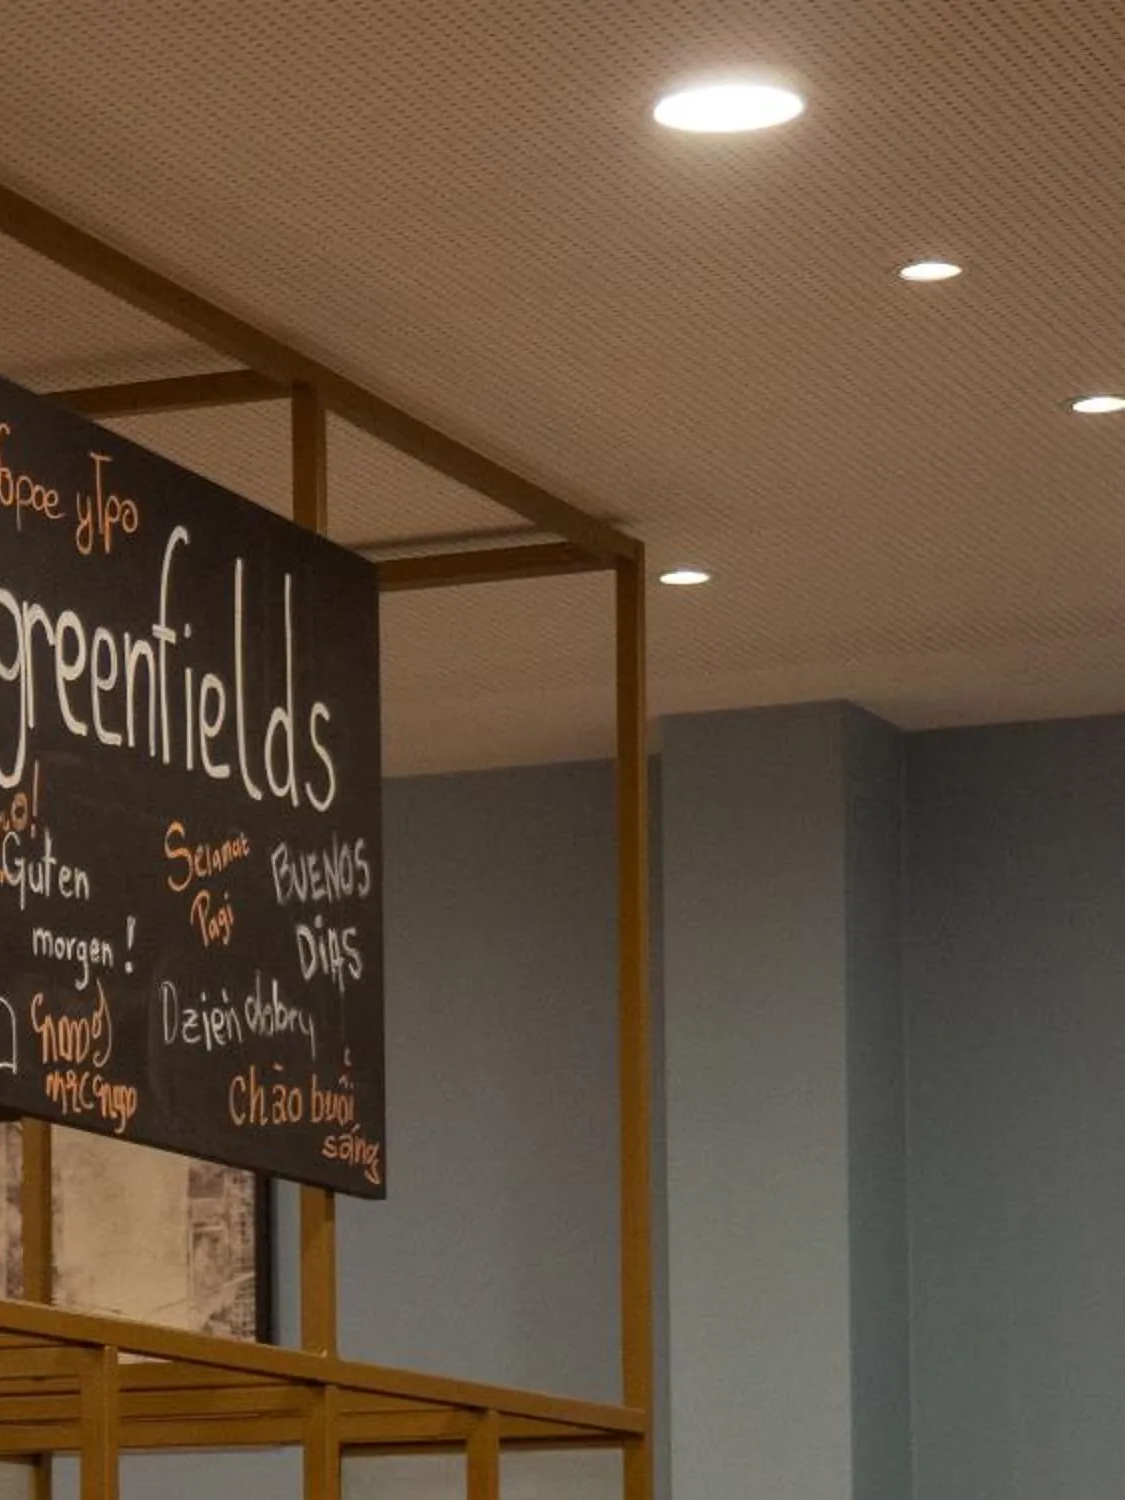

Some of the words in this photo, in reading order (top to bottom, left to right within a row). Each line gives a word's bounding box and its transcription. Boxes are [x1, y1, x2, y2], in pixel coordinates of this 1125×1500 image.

[2, 827, 90, 911] Guten
[164, 820, 250, 892] Selamat
[271, 832, 371, 905] BUENOS
[190, 889, 234, 947] Pagi
[245, 968, 316, 1061] dobry
[321, 1123, 380, 1185] sáng
